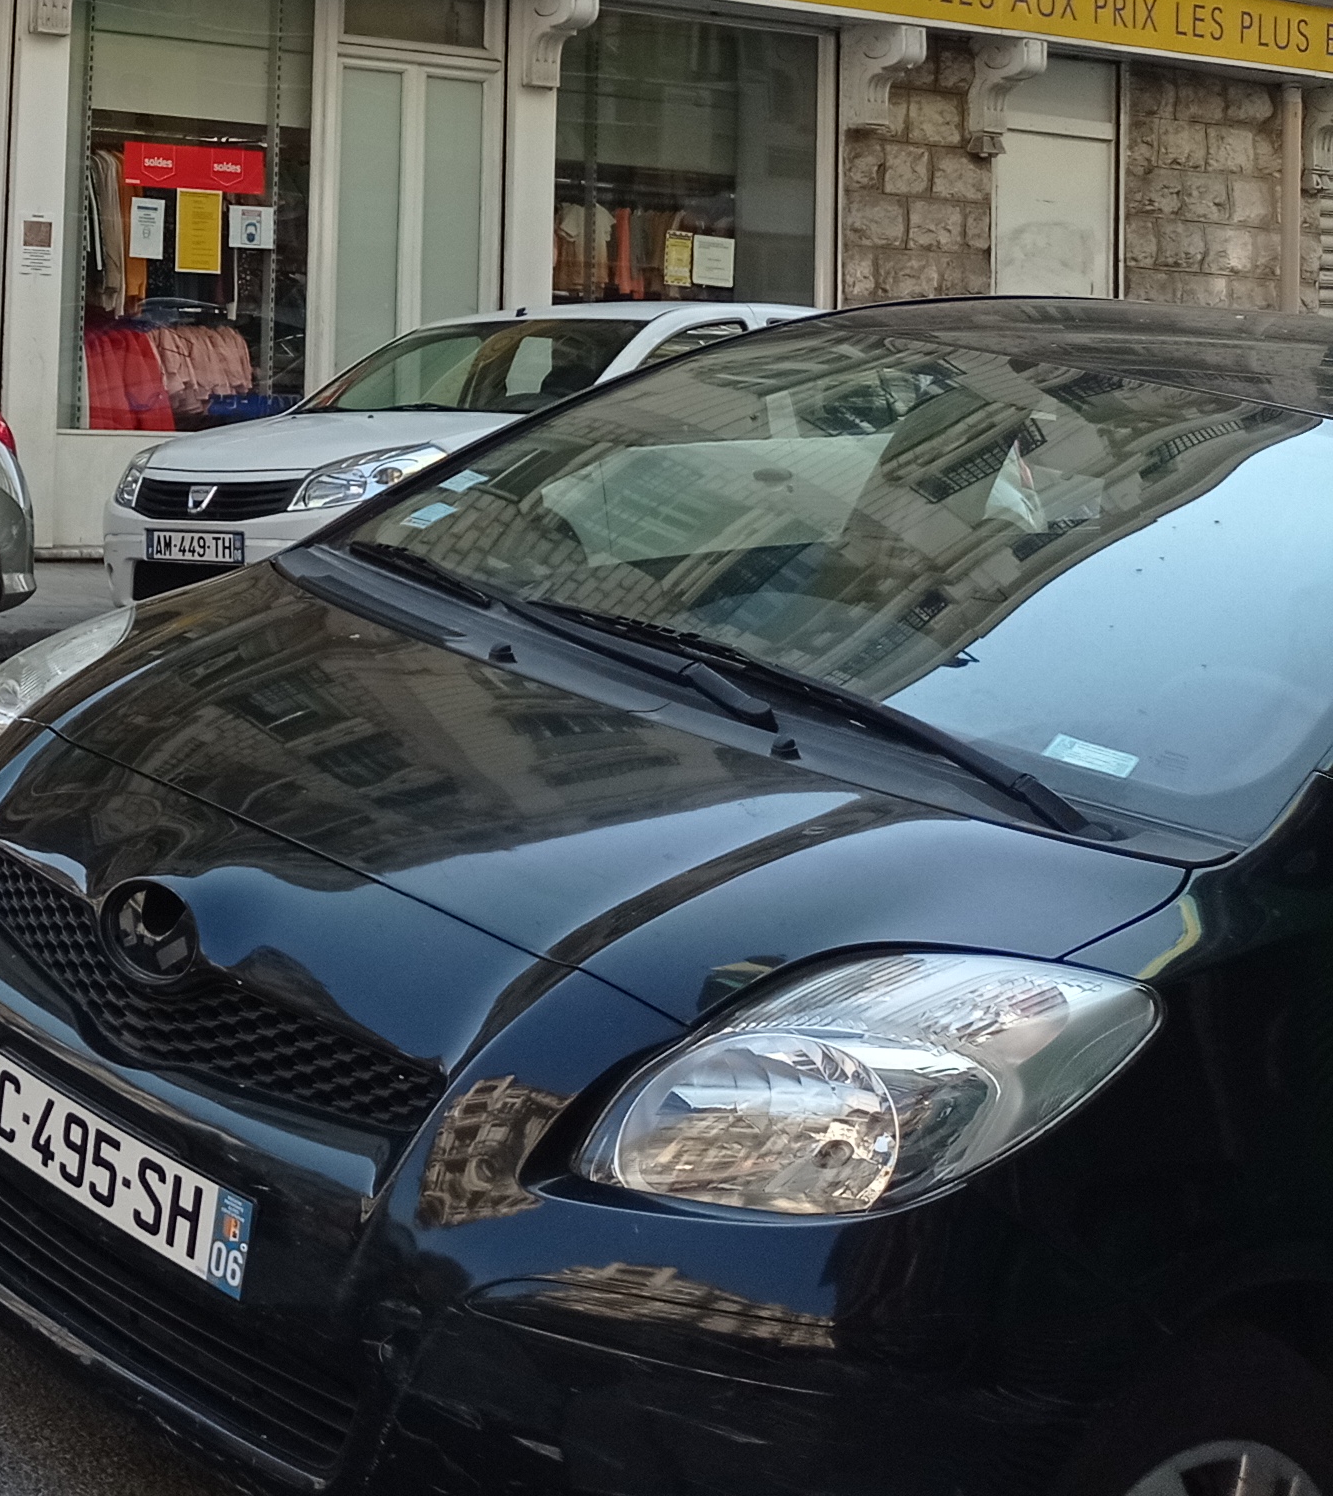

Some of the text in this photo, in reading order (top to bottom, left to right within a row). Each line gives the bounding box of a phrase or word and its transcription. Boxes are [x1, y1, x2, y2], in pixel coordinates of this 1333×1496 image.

[1173, 0, 1224, 41] LES
[1239, 10, 1310, 53] PLUS
[144, 156, 173, 168] soldes
[213, 162, 241, 173] soldes
[155, 534, 232, 560] AM-449-TH
[210, 1240, 244, 1287] 06
